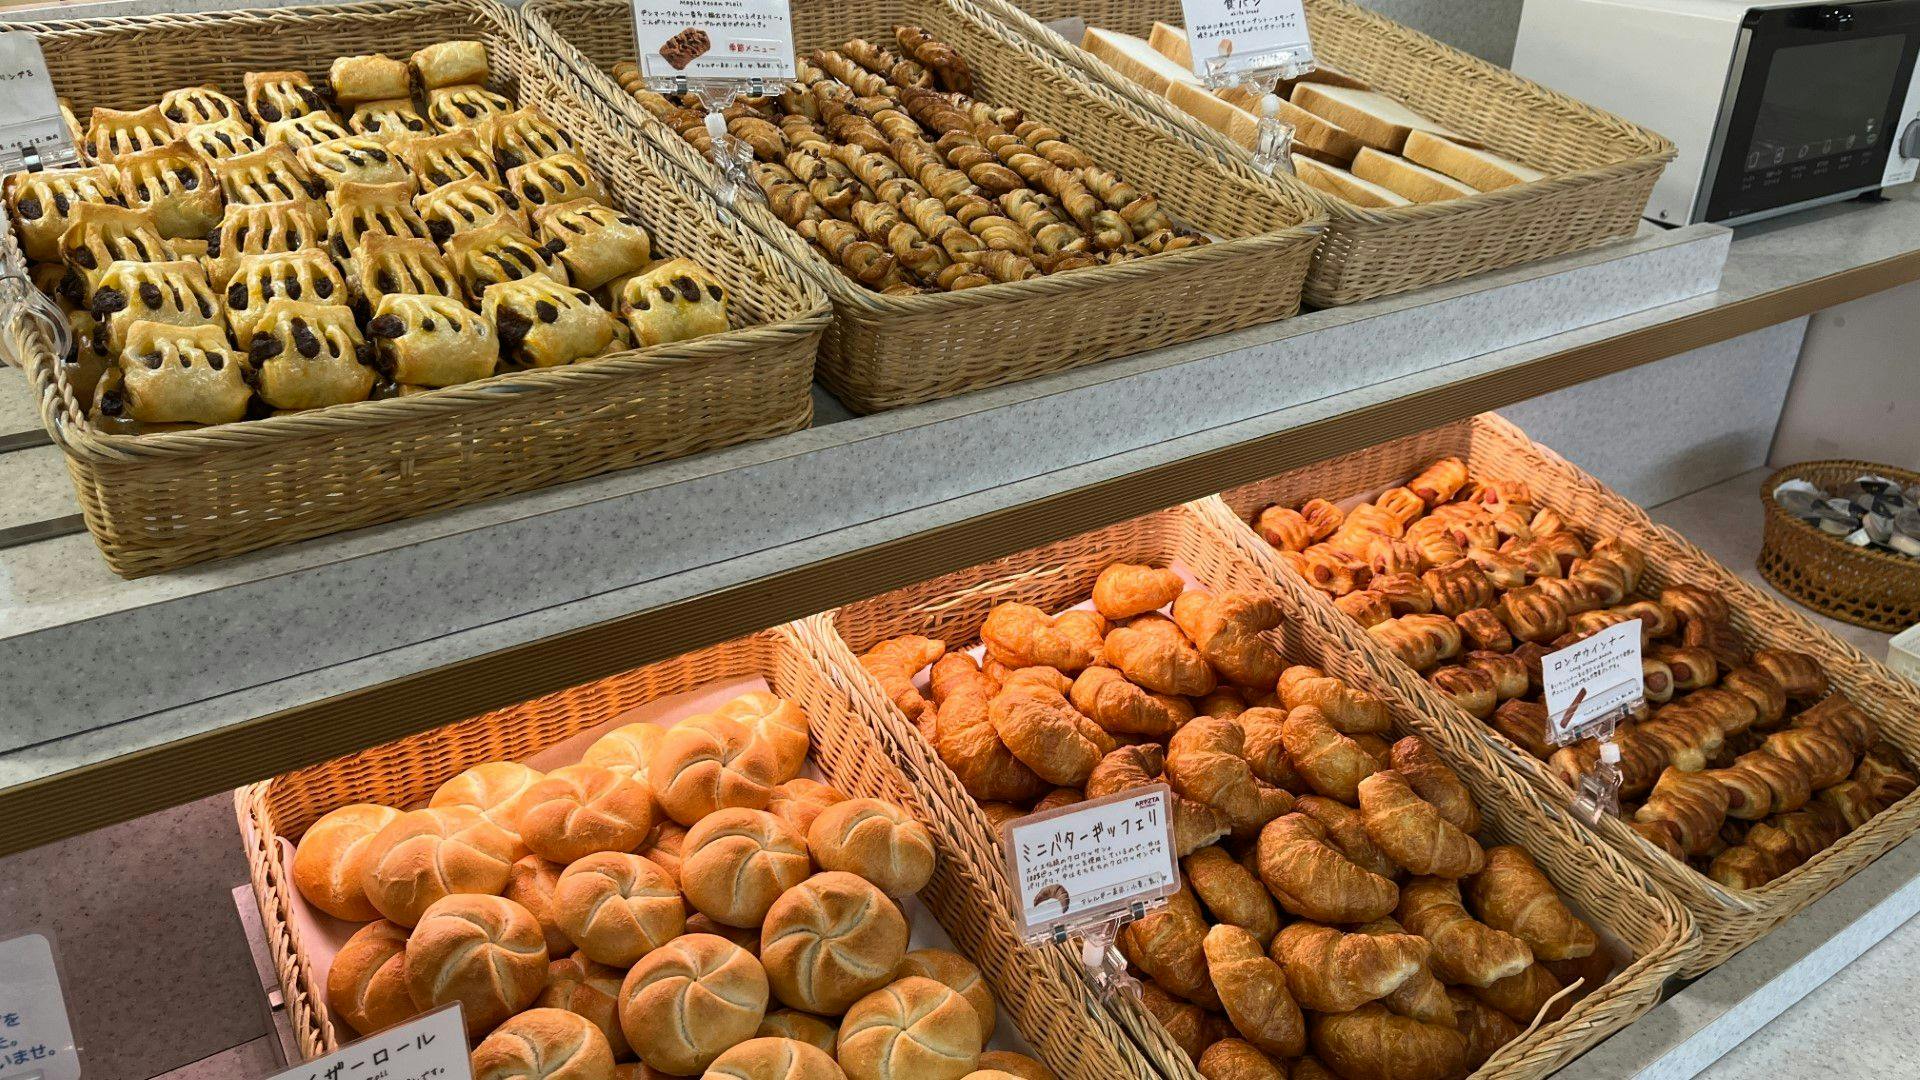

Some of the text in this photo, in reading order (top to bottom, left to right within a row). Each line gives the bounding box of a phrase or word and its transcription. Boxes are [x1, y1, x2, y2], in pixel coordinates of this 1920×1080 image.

[1023, 809, 1157, 862] ミニバターギッフェリ
[308, 1032, 436, 1080] ザーロール
